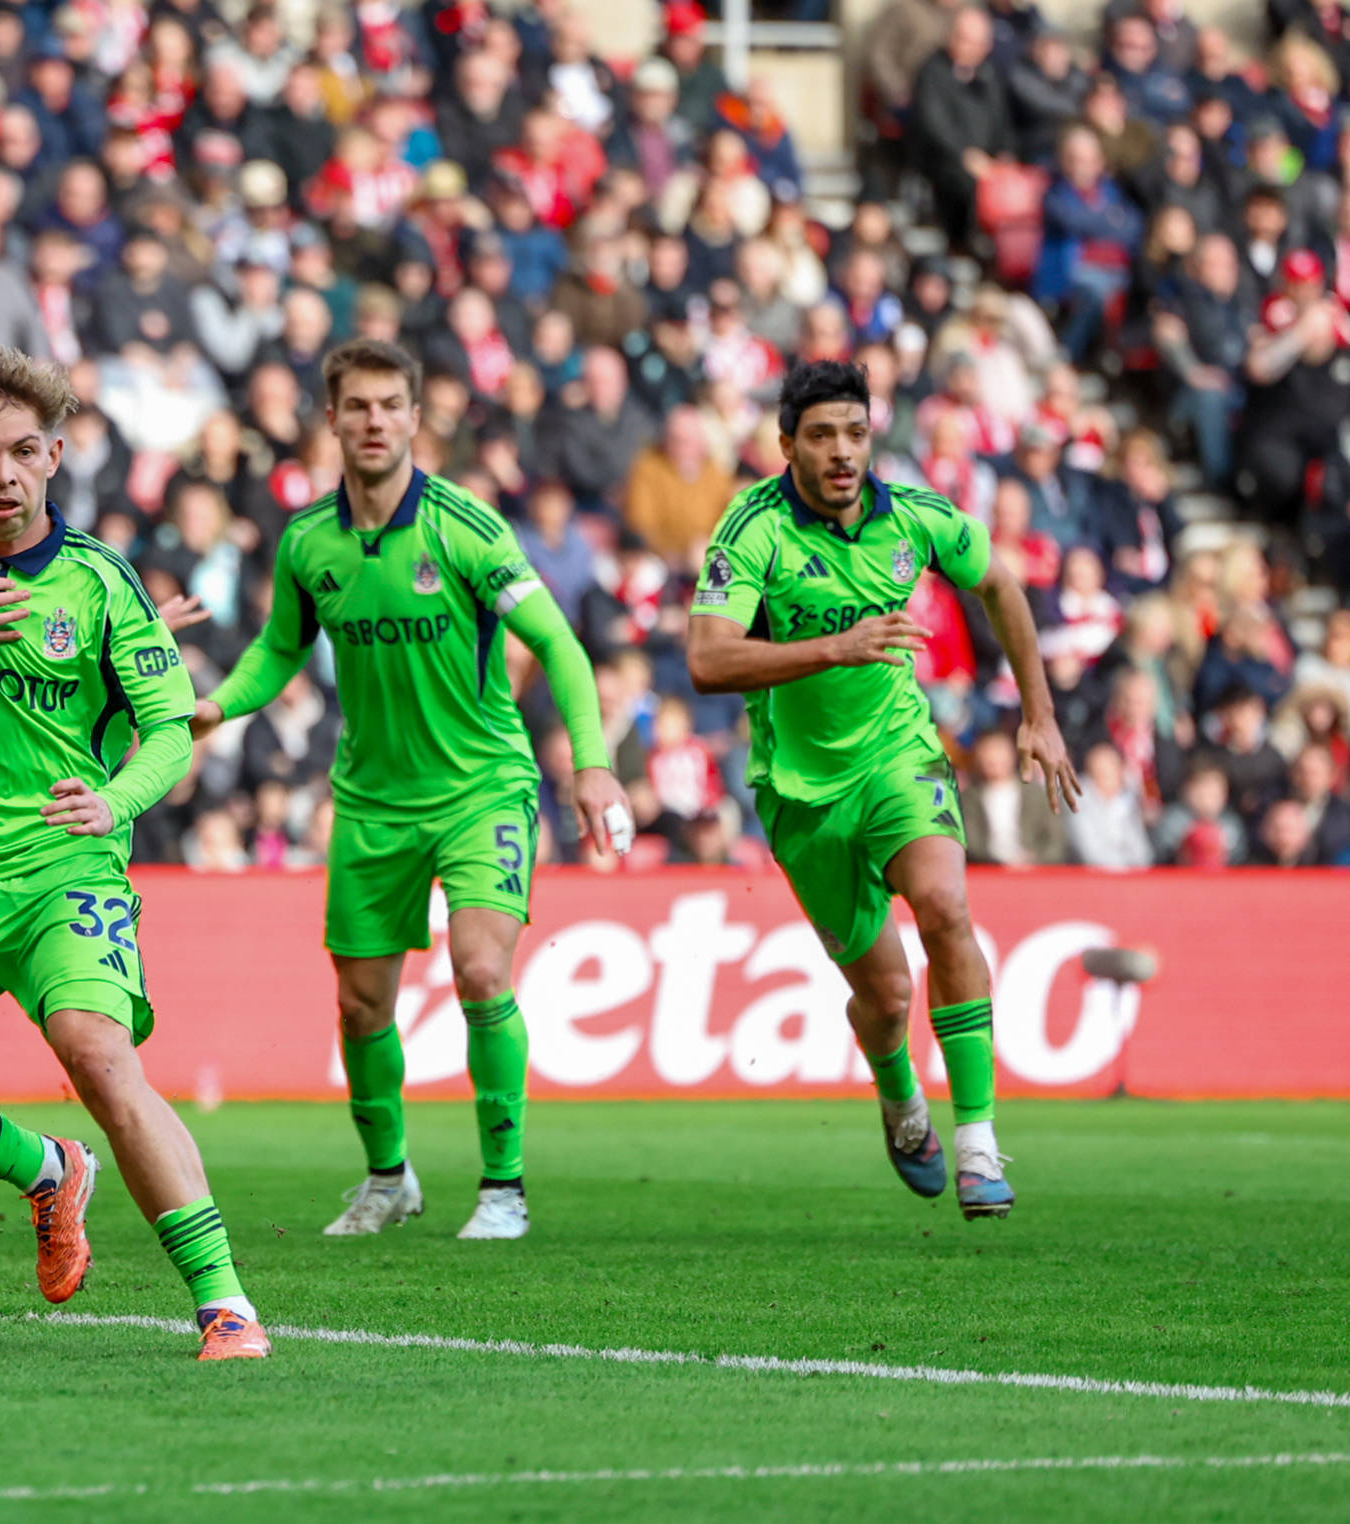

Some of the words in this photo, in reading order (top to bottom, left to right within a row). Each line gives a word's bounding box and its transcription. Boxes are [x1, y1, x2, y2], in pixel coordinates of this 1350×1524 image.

[343, 614, 450, 646] SBOTOP
[913, 775, 945, 807] 7
[495, 824, 524, 871] 5
[64, 890, 137, 953] 32
